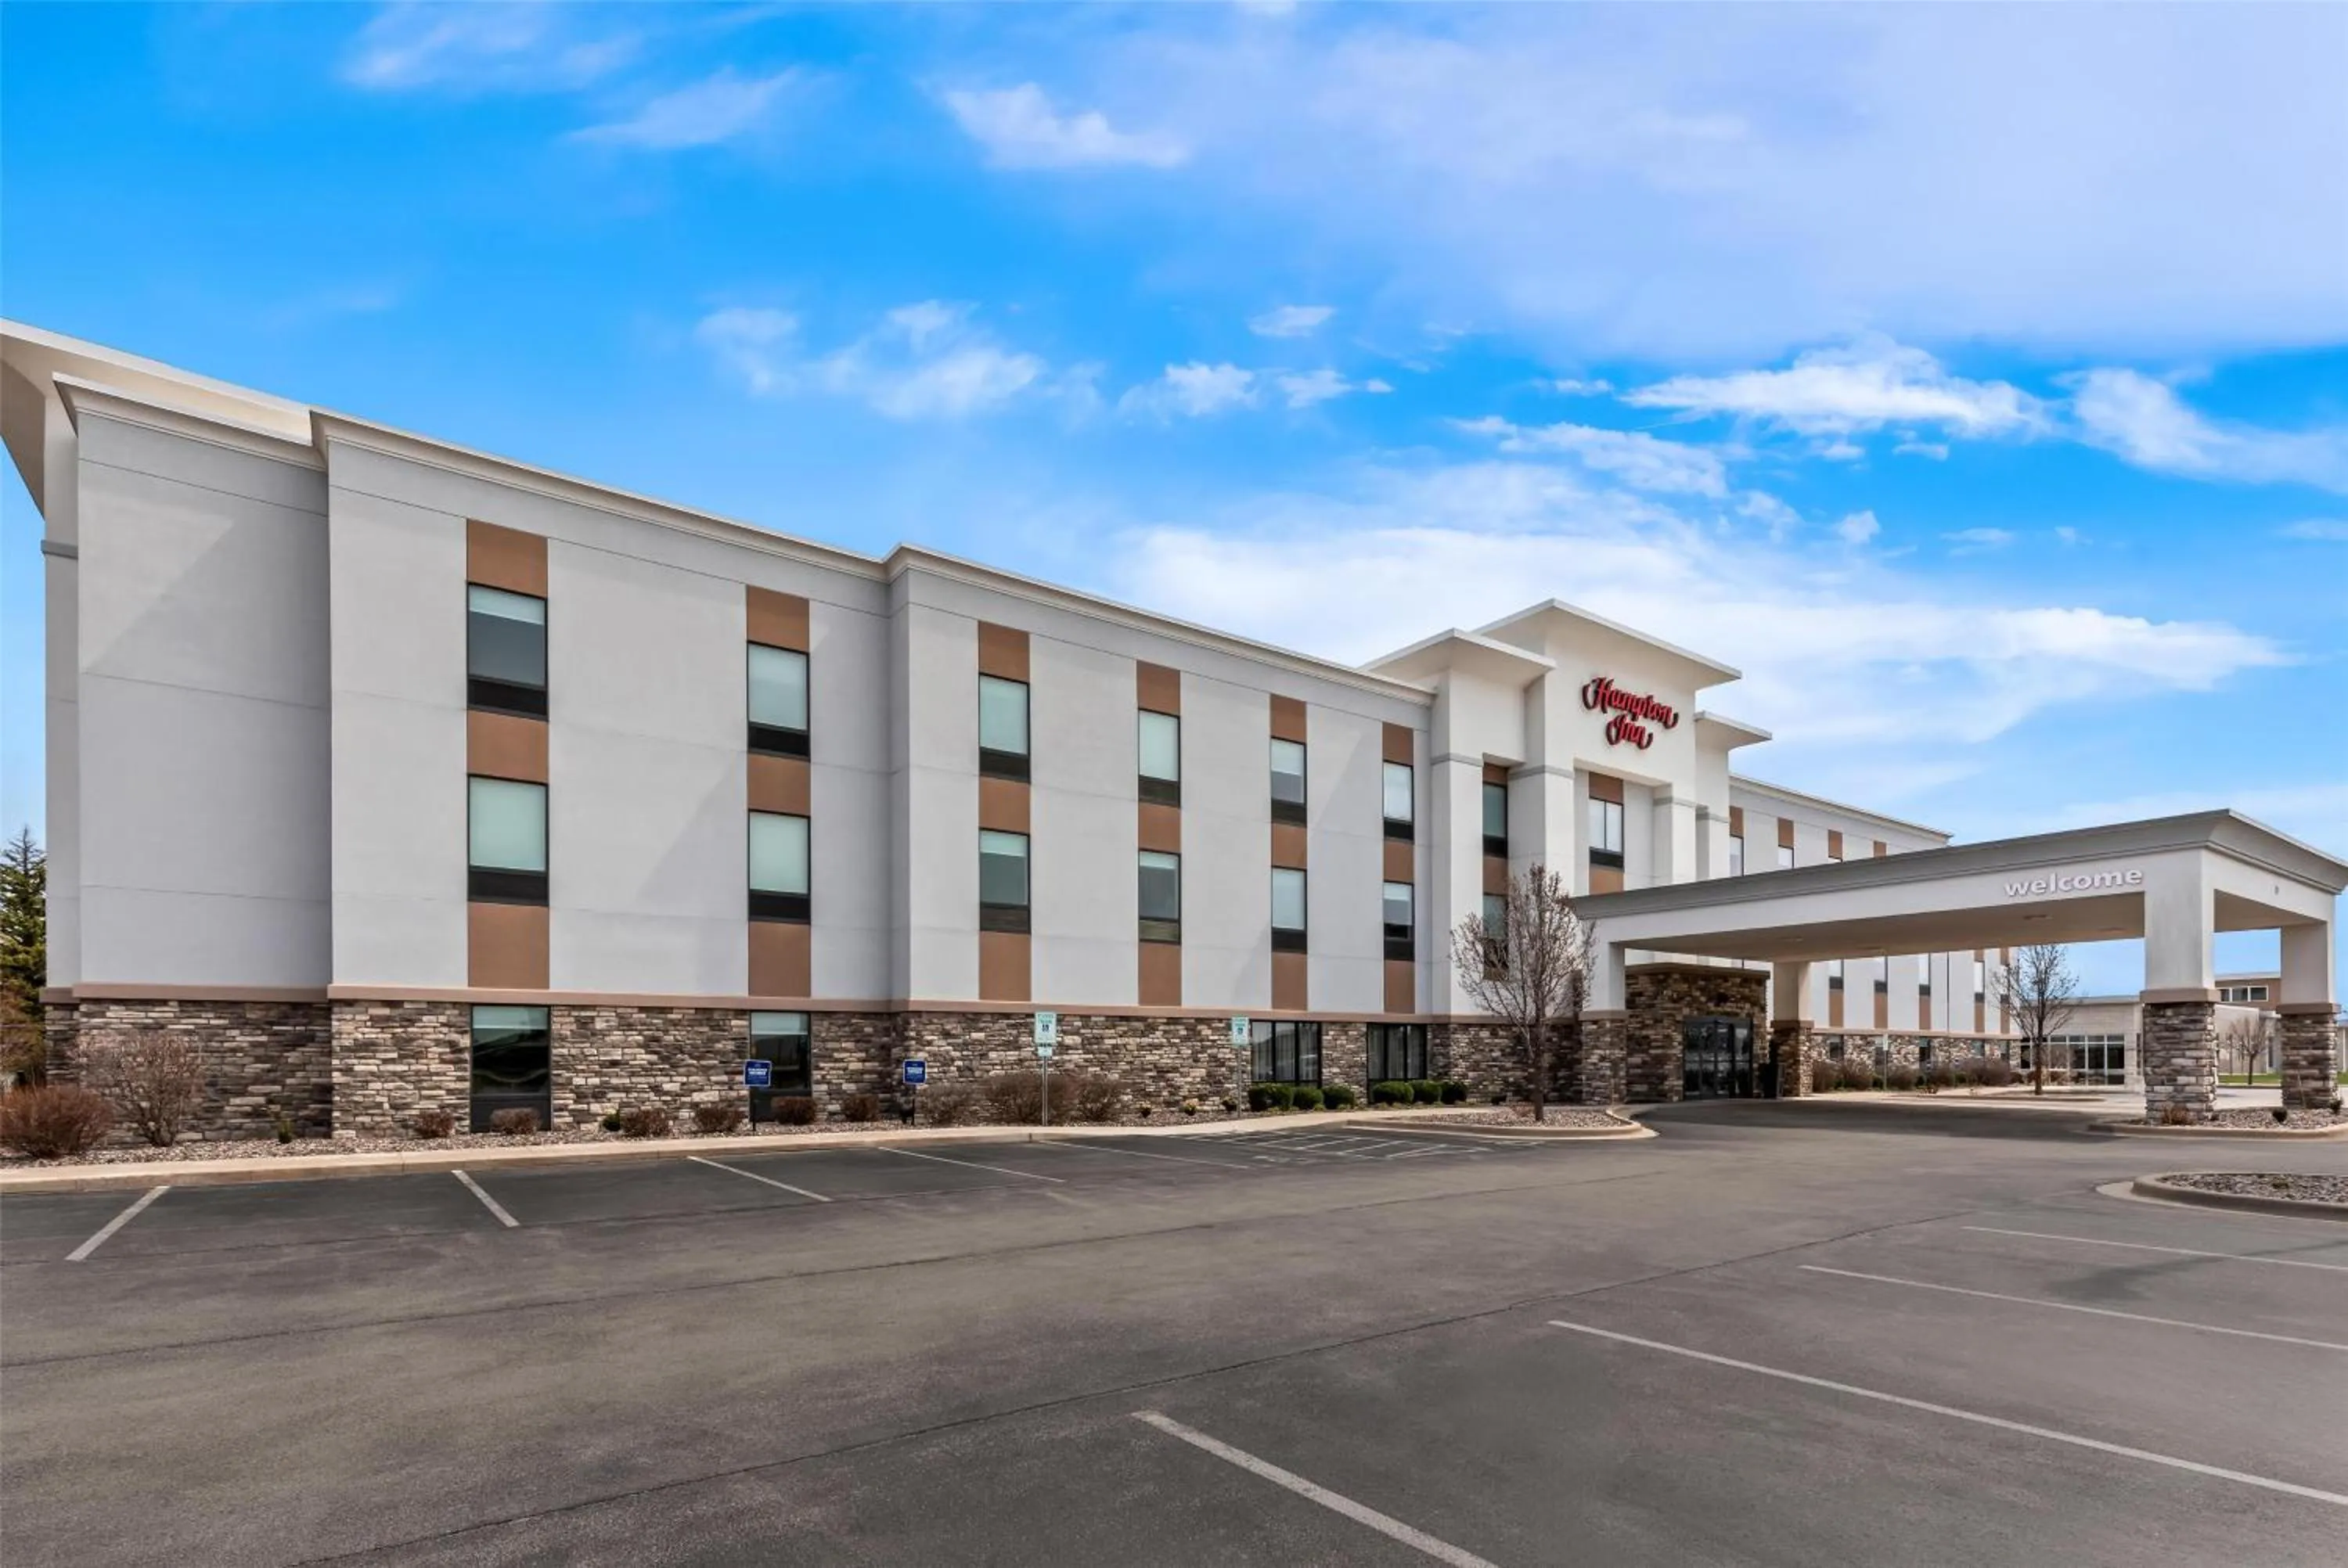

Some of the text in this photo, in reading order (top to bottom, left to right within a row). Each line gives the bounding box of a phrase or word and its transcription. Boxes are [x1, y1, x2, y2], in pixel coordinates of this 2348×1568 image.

[1582, 677, 1680, 729] Hampton
[1605, 714, 1653, 750] Inn
[2004, 869, 2143, 897] welcome
